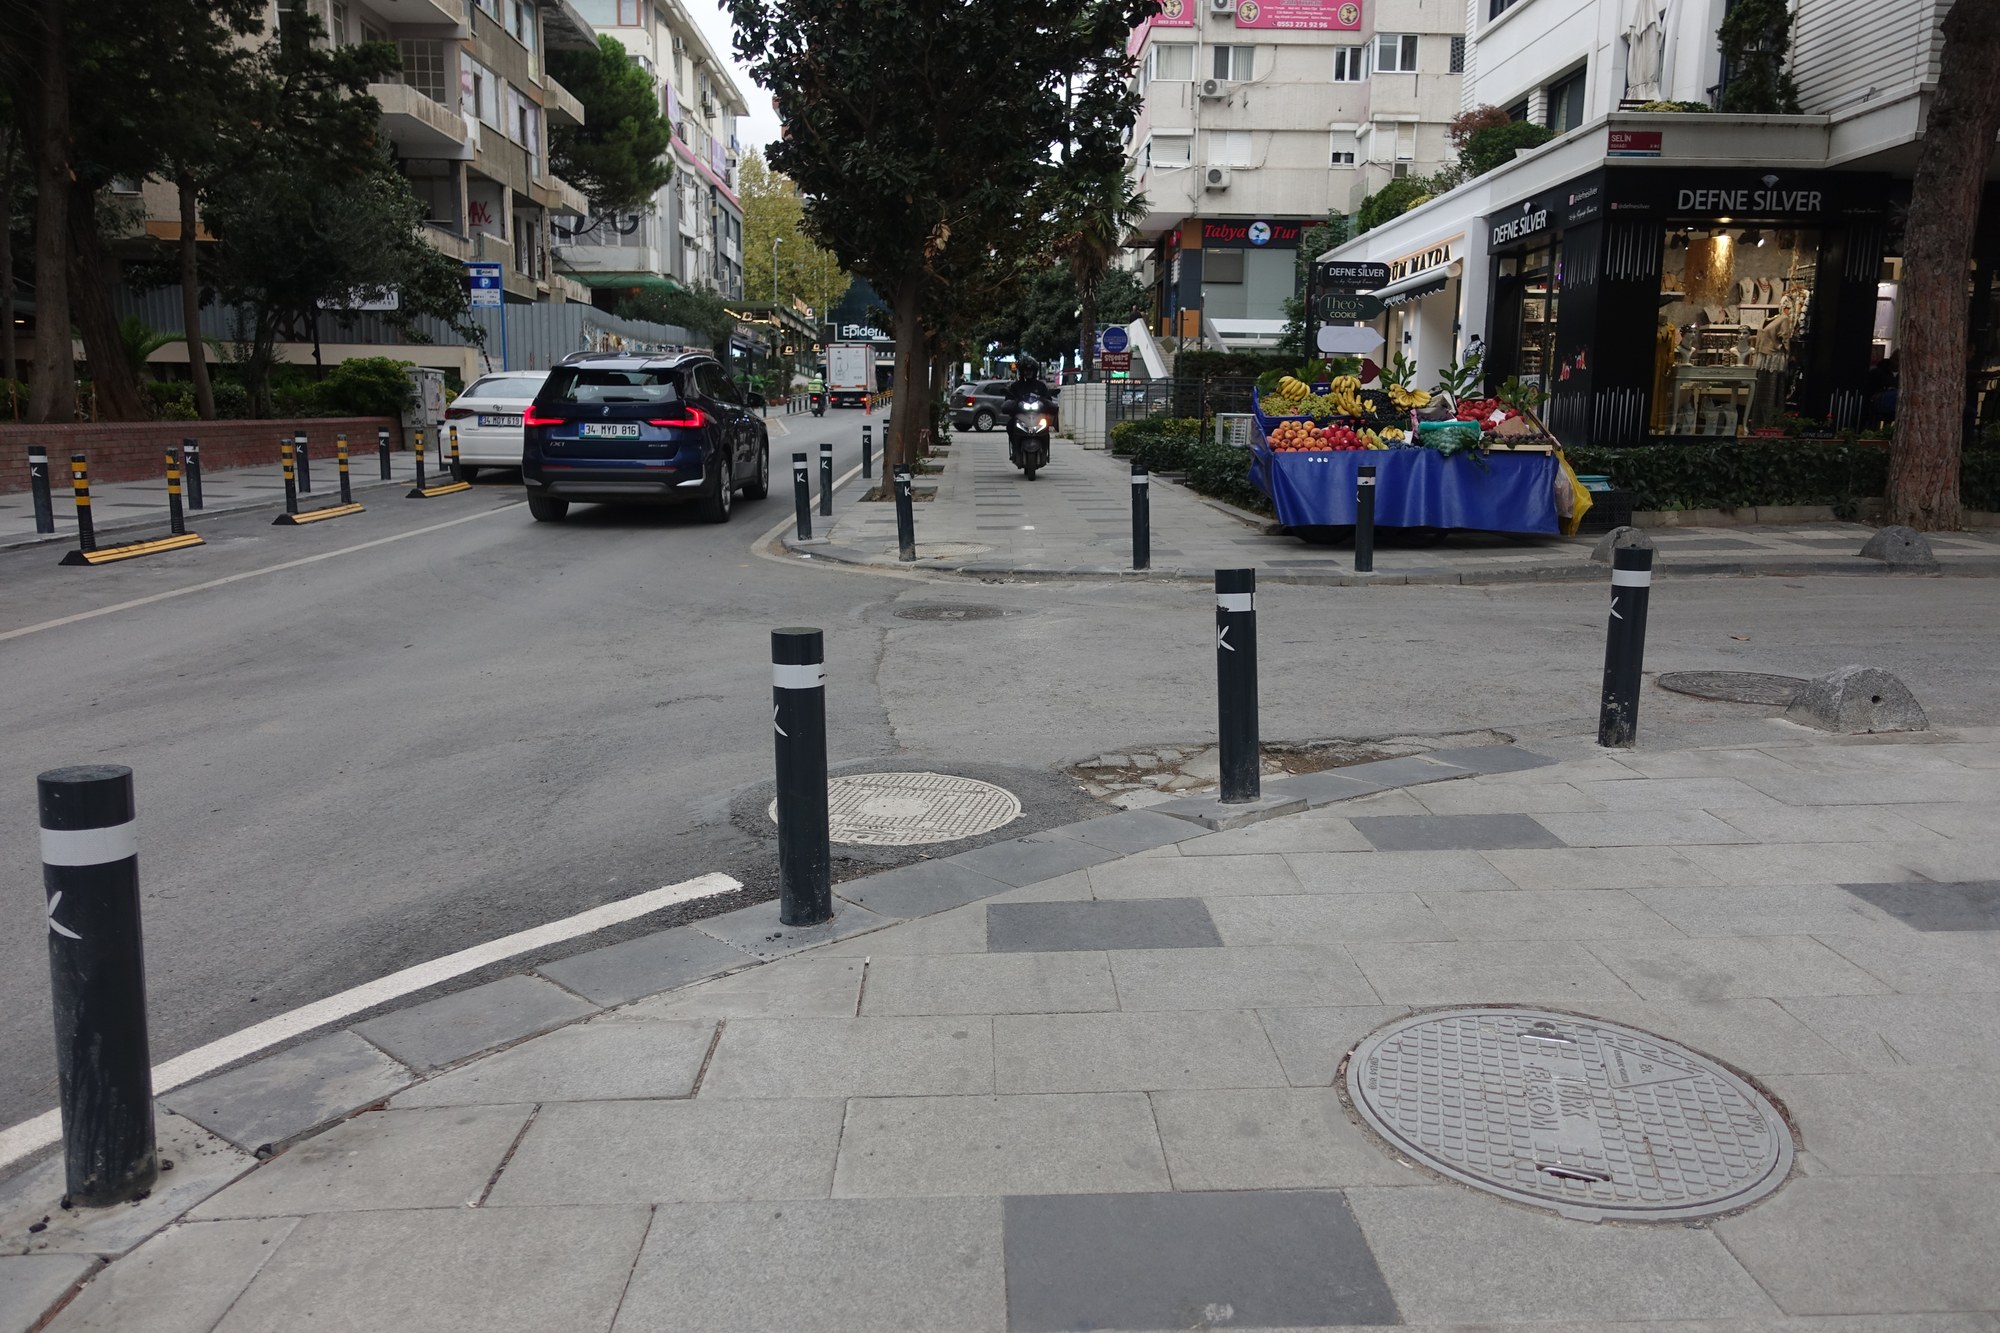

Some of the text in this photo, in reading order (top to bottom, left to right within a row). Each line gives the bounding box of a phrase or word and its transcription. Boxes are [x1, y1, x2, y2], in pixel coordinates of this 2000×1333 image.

[1611, 133, 1631, 142] SELİN
[1677, 189, 1822, 212] DEFNE SILVER
[1205, 224, 1299, 241] Tabya Tur
[1493, 209, 1547, 245] DEFNE SILVER
[1410, 244, 1451, 274] MAYDA
[1329, 267, 1385, 277] DEFNE SILVER
[1327, 296, 1365, 310] Theo's
[1329, 311, 1357, 319] COOKIE
[585, 424, 596, 434] 34
[621, 425, 636, 435] 816
